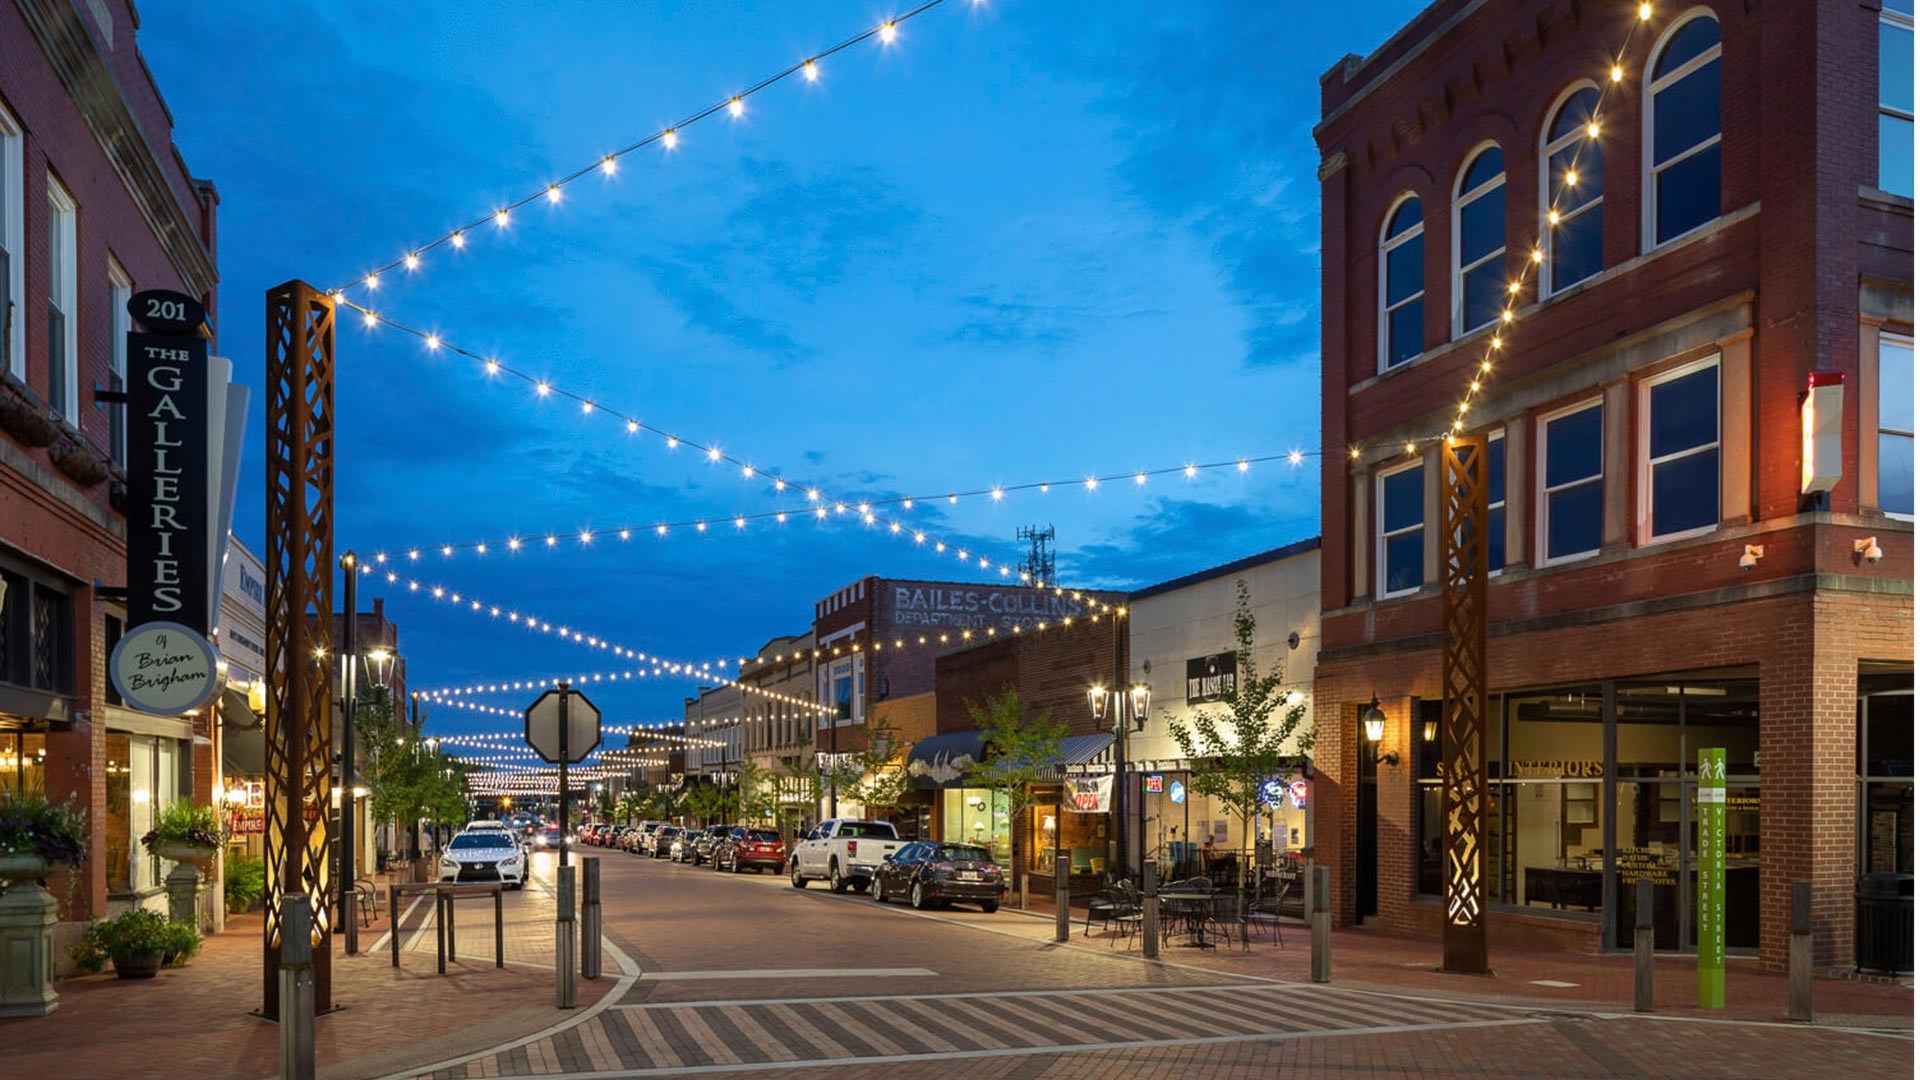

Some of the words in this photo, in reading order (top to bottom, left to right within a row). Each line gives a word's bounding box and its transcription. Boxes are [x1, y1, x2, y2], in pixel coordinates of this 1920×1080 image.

[146, 298, 186, 321] 201
[144, 346, 189, 361] THE
[147, 366, 187, 612] GALLERIES
[895, 610, 986, 629] DEPARTMENT
[156, 634, 167, 649] Of
[134, 652, 193, 669] Brian
[127, 667, 206, 692] Brigham
[1189, 678, 1200, 699] THE
[1508, 761, 1603, 777] INTERIORS
[1075, 793, 1099, 810] OPEN
[1715, 808, 1723, 890] VICTORIA
[1715, 903, 1723, 965] STREET
